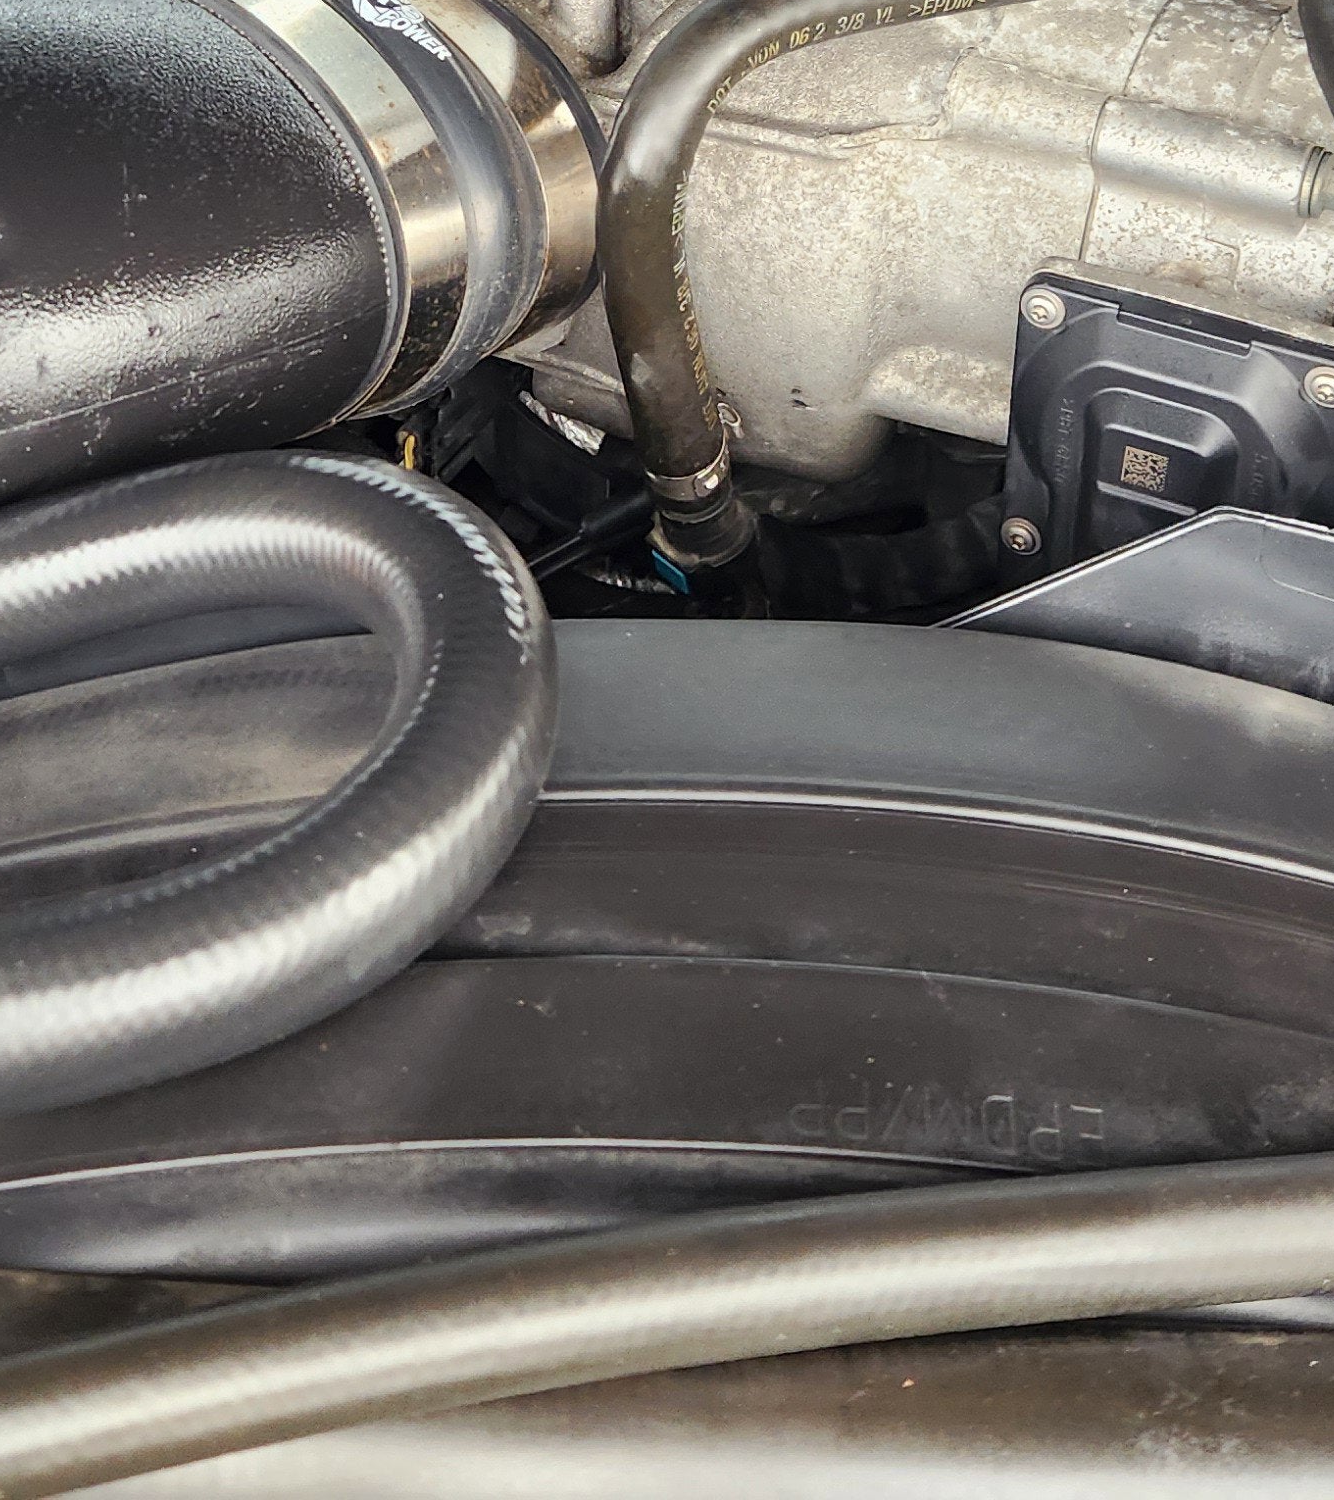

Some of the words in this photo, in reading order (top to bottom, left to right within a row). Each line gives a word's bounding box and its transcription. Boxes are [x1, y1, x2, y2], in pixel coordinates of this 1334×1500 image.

[378, 10, 453, 61] POWER
[707, 75, 734, 114] DOT
[835, 11, 865, 37] 3/8
